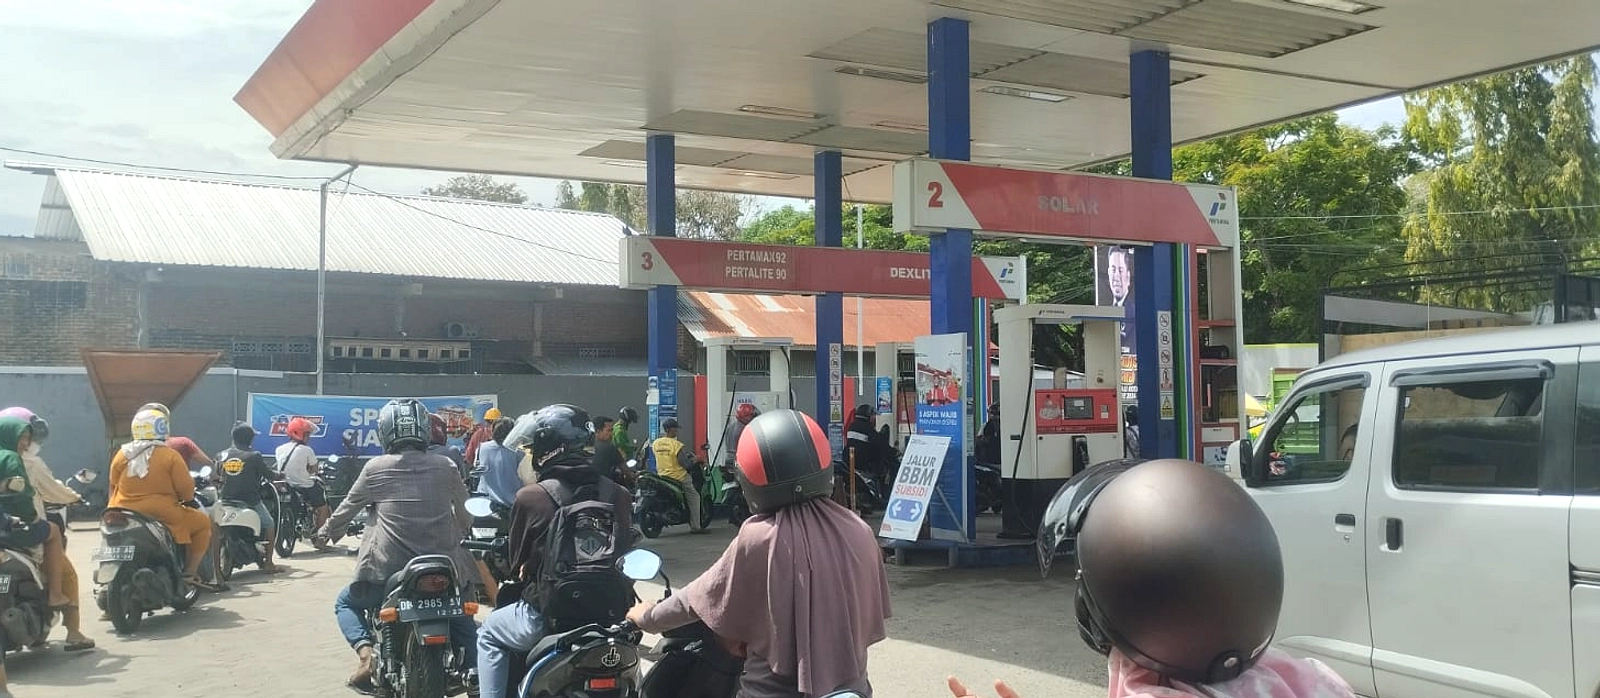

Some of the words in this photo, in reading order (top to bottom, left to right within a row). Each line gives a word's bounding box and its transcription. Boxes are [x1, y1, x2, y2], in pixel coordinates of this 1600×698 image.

[928, 182, 943, 208] 2
[1037, 195, 1099, 216] SOLAR
[641, 252, 653, 270] 3
[725, 266, 774, 280] PERTALITE
[775, 268, 787, 280] 90
[890, 267, 931, 280] DEXLIT
[349, 407, 381, 427] SP
[342, 429, 381, 448] SIA
[906, 454, 937, 467] JALUR
[898, 466, 935, 486] BBM
[895, 484, 930, 498] SUBSIDI
[417, 598, 442, 609] 2985
